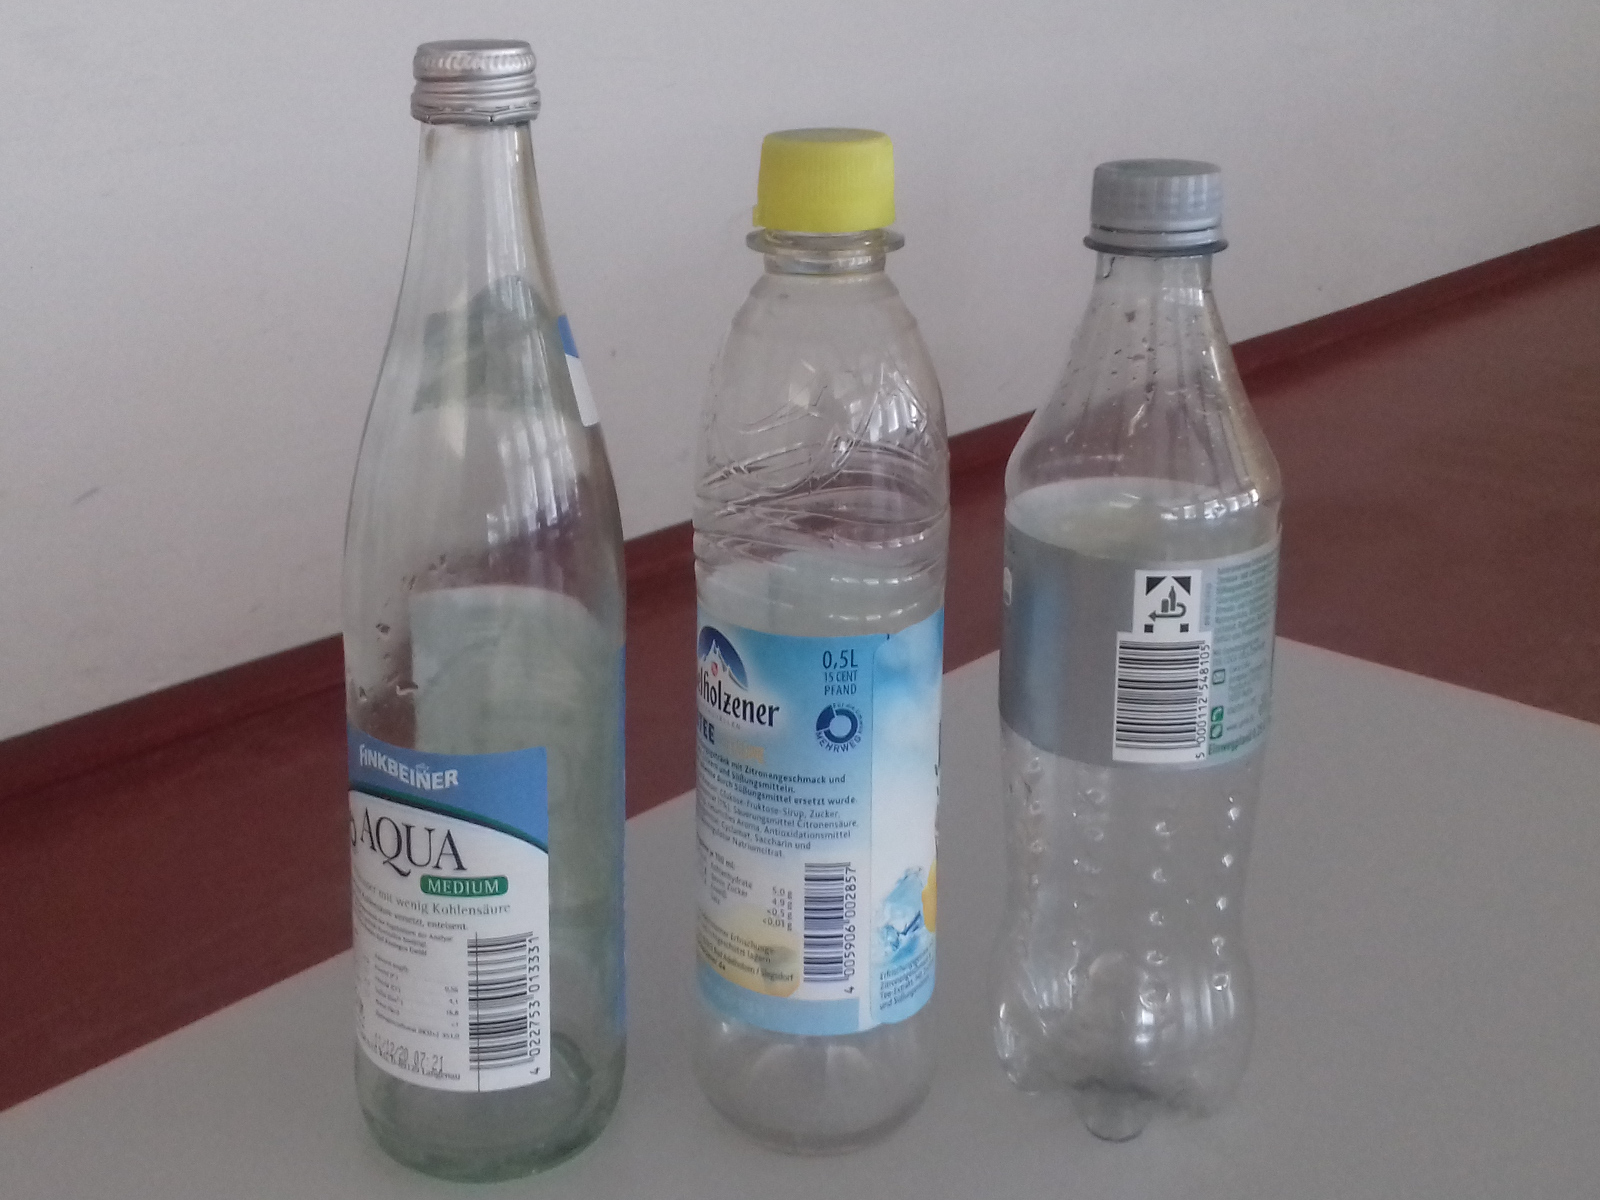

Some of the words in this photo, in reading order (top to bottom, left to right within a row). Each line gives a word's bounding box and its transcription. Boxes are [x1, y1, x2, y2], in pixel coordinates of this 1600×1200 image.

[822, 649, 859, 669] 0,5L
[824, 671, 834, 682] 15
[836, 670, 858, 682] CENT
[824, 683, 857, 696] PFAND
[360, 743, 459, 790] FINKBEINER
[744, 764, 826, 785] Zitronengeschmack
[828, 774, 846, 784] und
[794, 797, 826, 806] ersetzt
[361, 807, 468, 877] AQUA
[795, 841, 811, 850] und
[428, 878, 500, 895] MEDIUM
[395, 897, 429, 915] wenig
[432, 902, 511, 917] Kohlensäure
